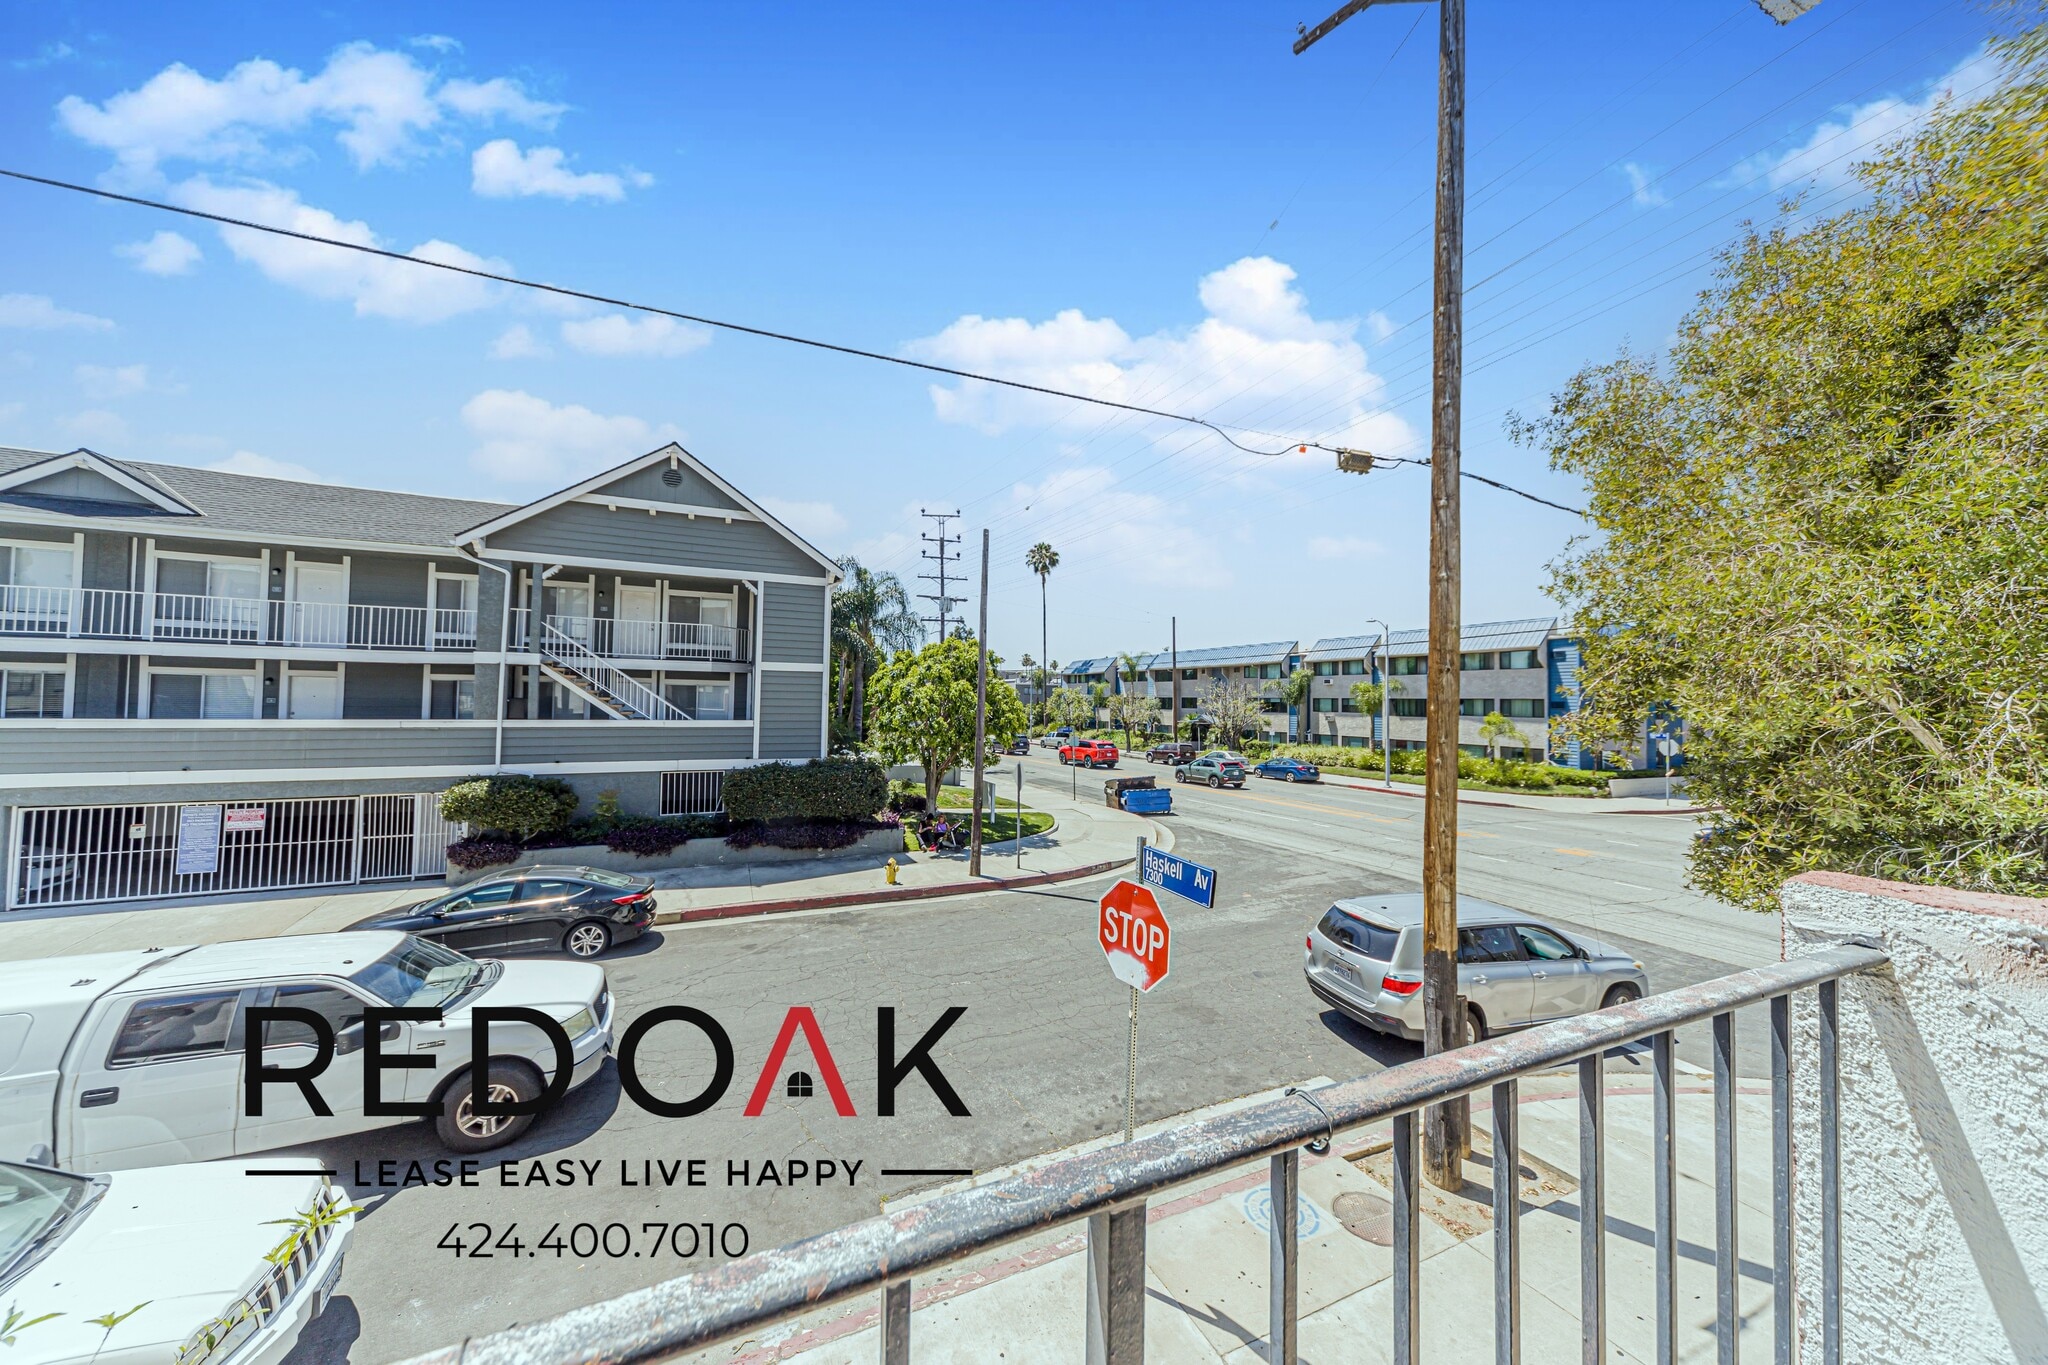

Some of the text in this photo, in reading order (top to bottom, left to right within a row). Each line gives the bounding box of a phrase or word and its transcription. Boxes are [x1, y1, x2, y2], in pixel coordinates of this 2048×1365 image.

[1145, 850, 1208, 890] Haskell Av
[1145, 868, 1163, 885] 7300
[1104, 907, 1164, 962] STOP
